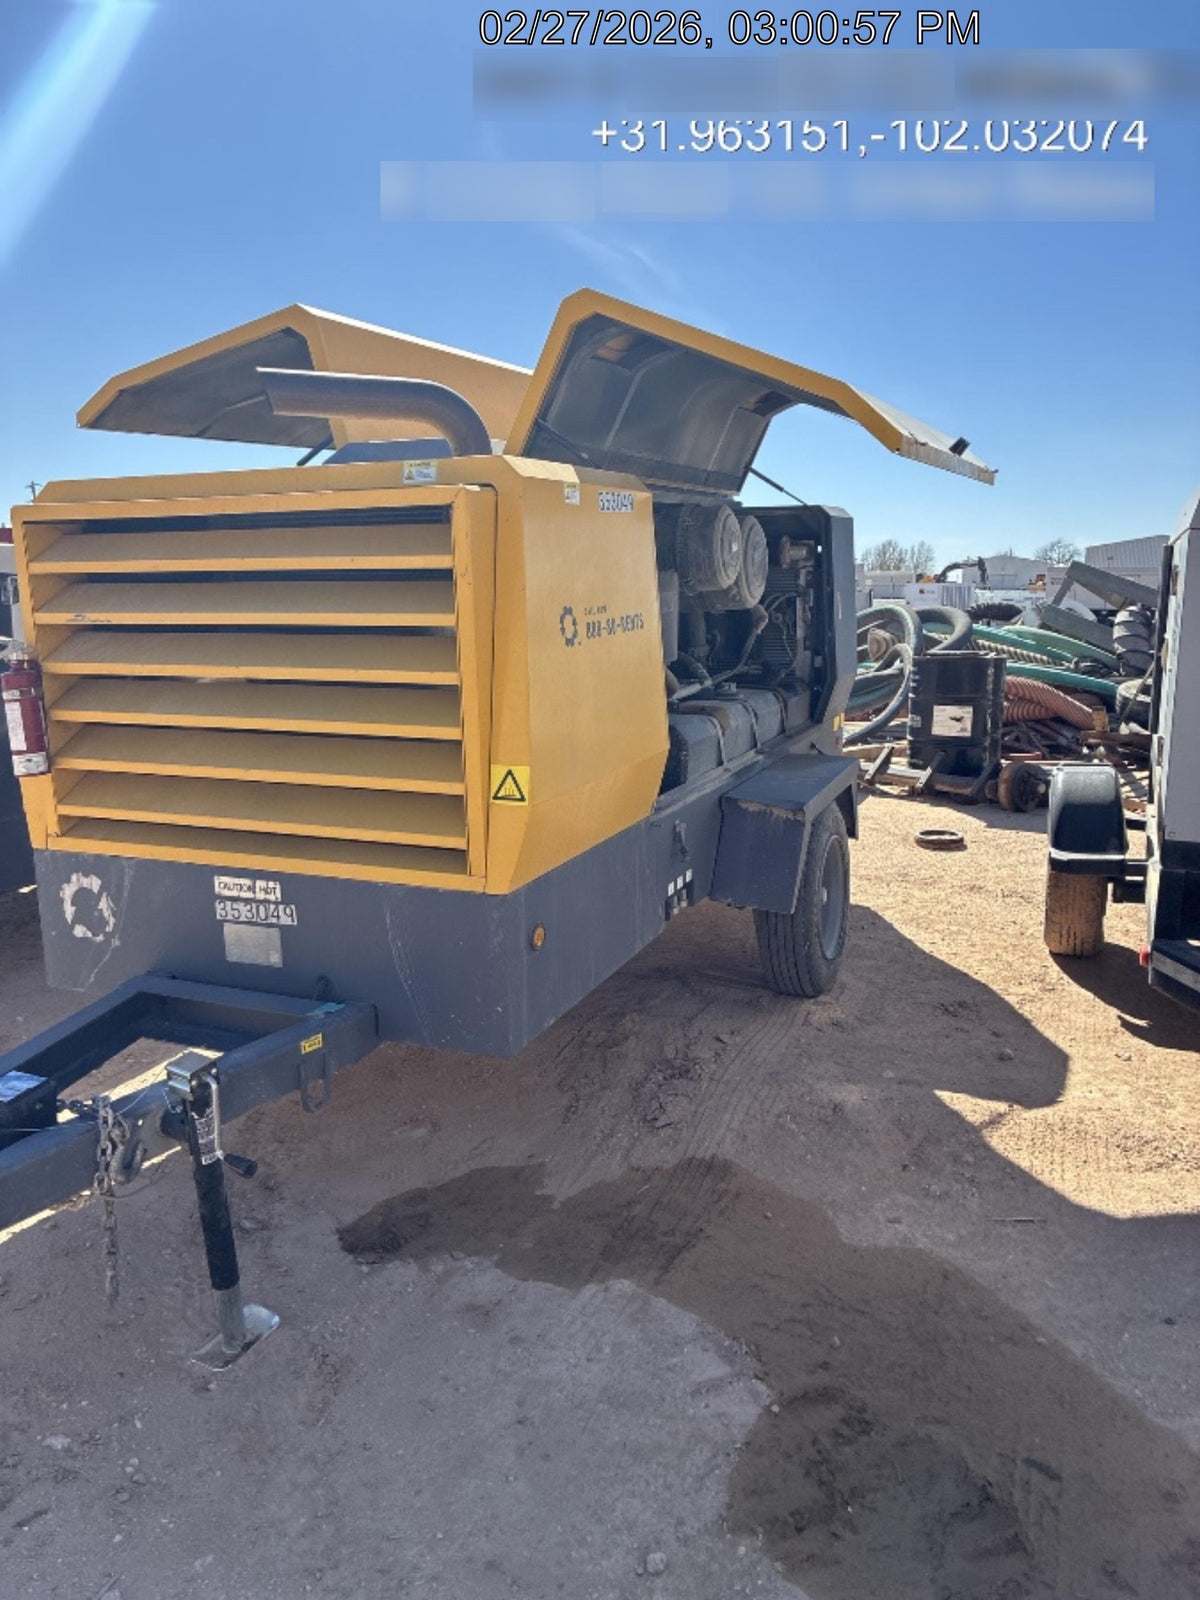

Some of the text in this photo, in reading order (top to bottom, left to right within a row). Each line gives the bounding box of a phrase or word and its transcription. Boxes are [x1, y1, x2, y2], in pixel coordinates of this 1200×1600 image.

[217, 881, 278, 895] CAUTION HOT
[217, 900, 297, 924] 353049
